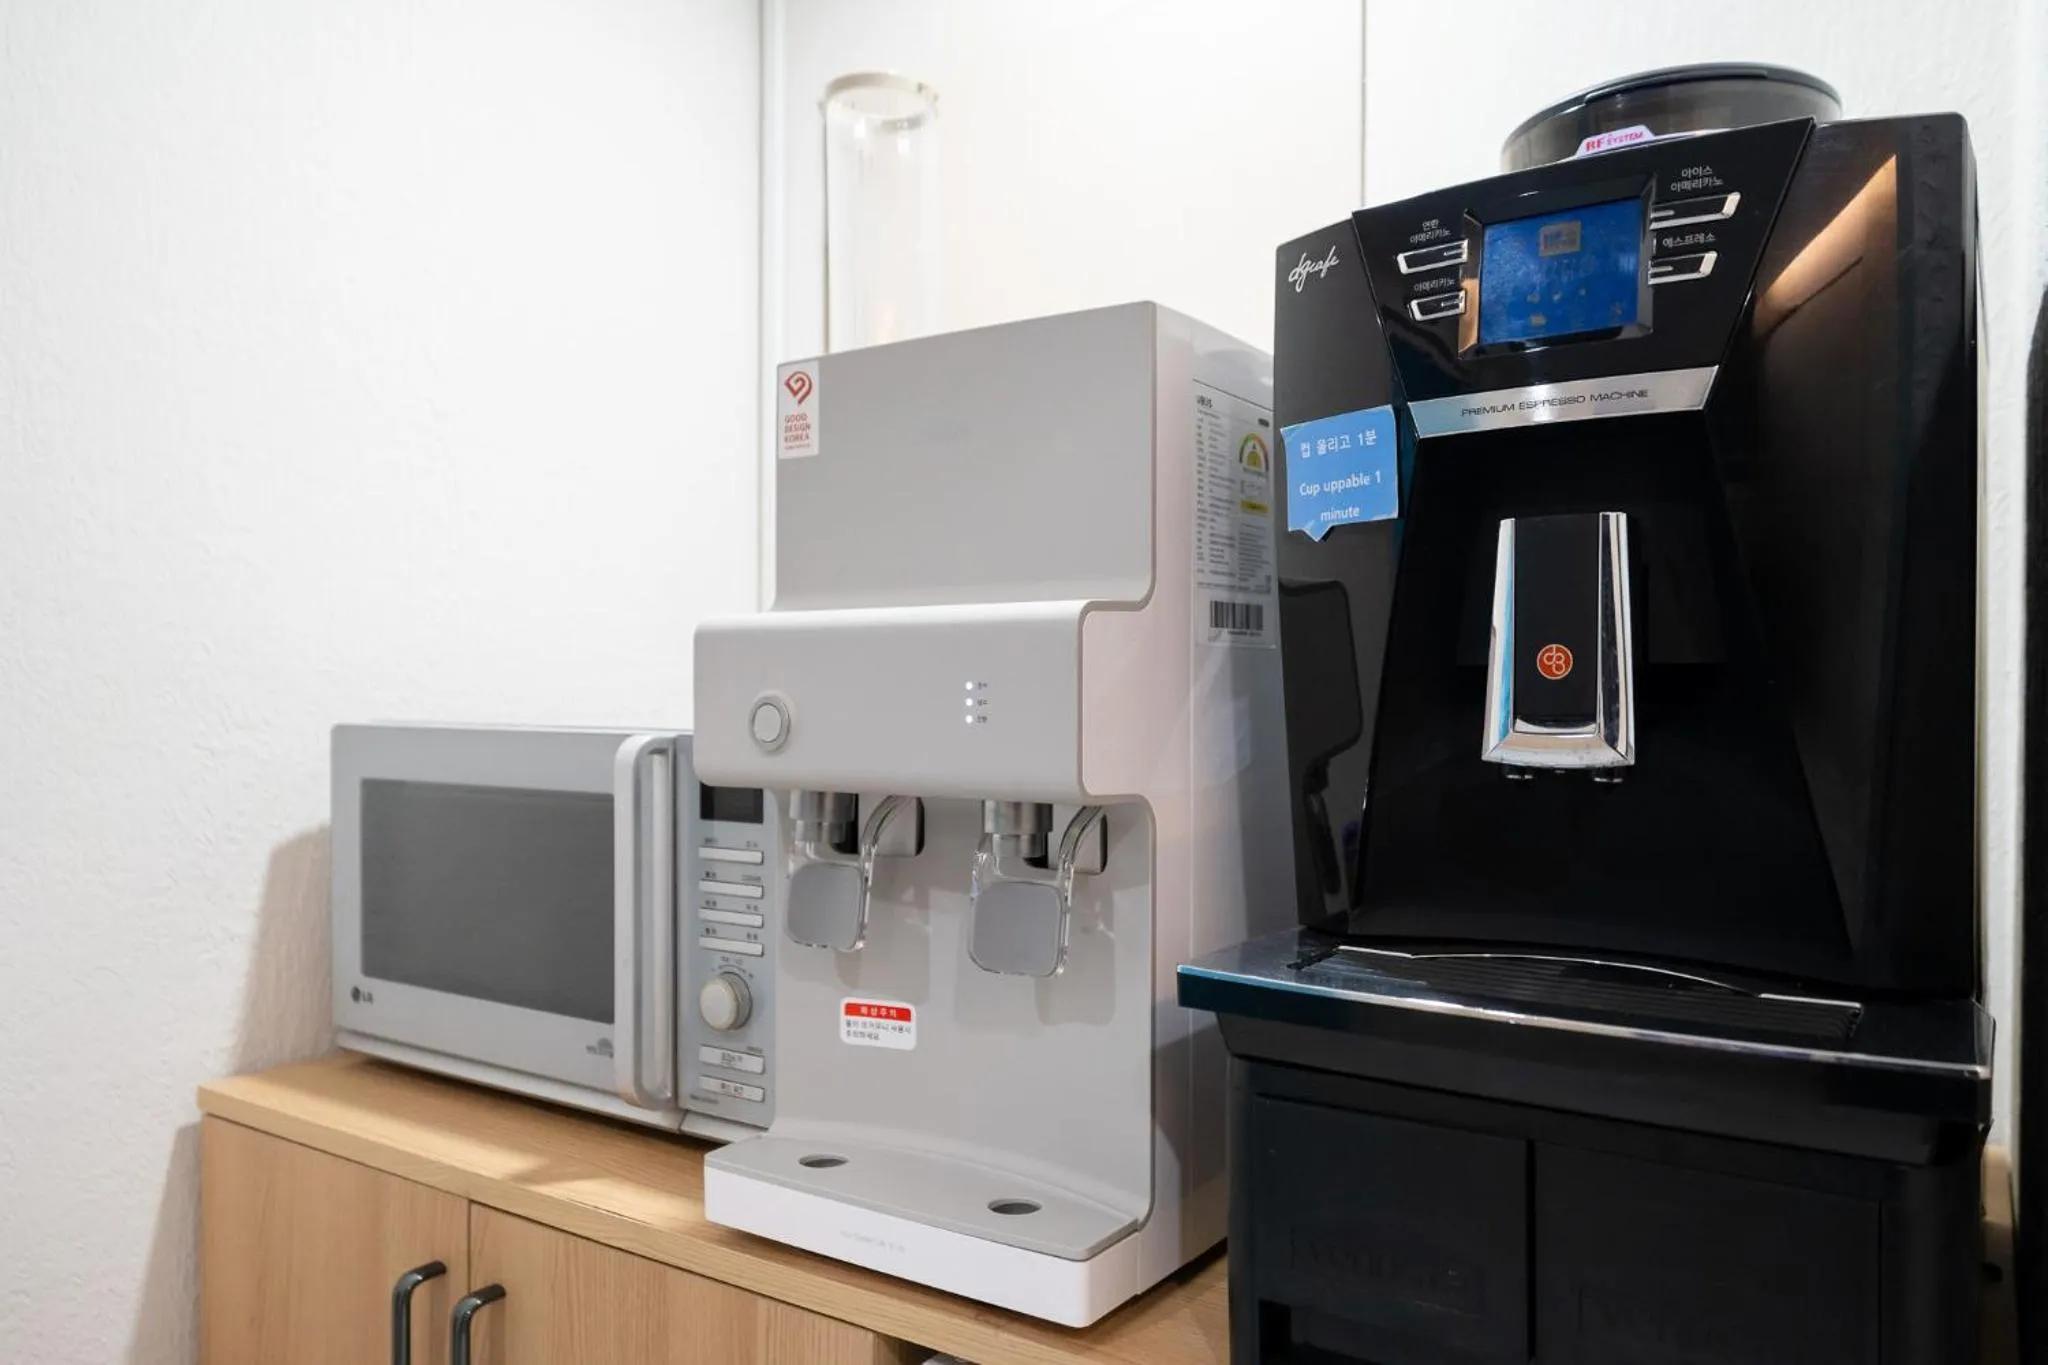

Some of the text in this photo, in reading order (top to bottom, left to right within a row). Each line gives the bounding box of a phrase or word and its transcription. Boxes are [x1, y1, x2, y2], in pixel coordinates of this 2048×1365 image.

[1607, 131, 1643, 146] SYSTEM
[1681, 165, 1713, 178] 아이스
[1670, 176, 1723, 192] 아메리카노
[1410, 229, 1452, 243] 아메리카노
[1662, 232, 1716, 248] 에스프레소
[1413, 278, 1455, 292] 아메리카노
[1461, 389, 1649, 417] PREMIUM ESPRESSO MACHINE
[1300, 428, 1377, 459] 컵 올리고 1분
[1299, 470, 1381, 497] Cup uppable 1
[1320, 505, 1360, 522] minute
